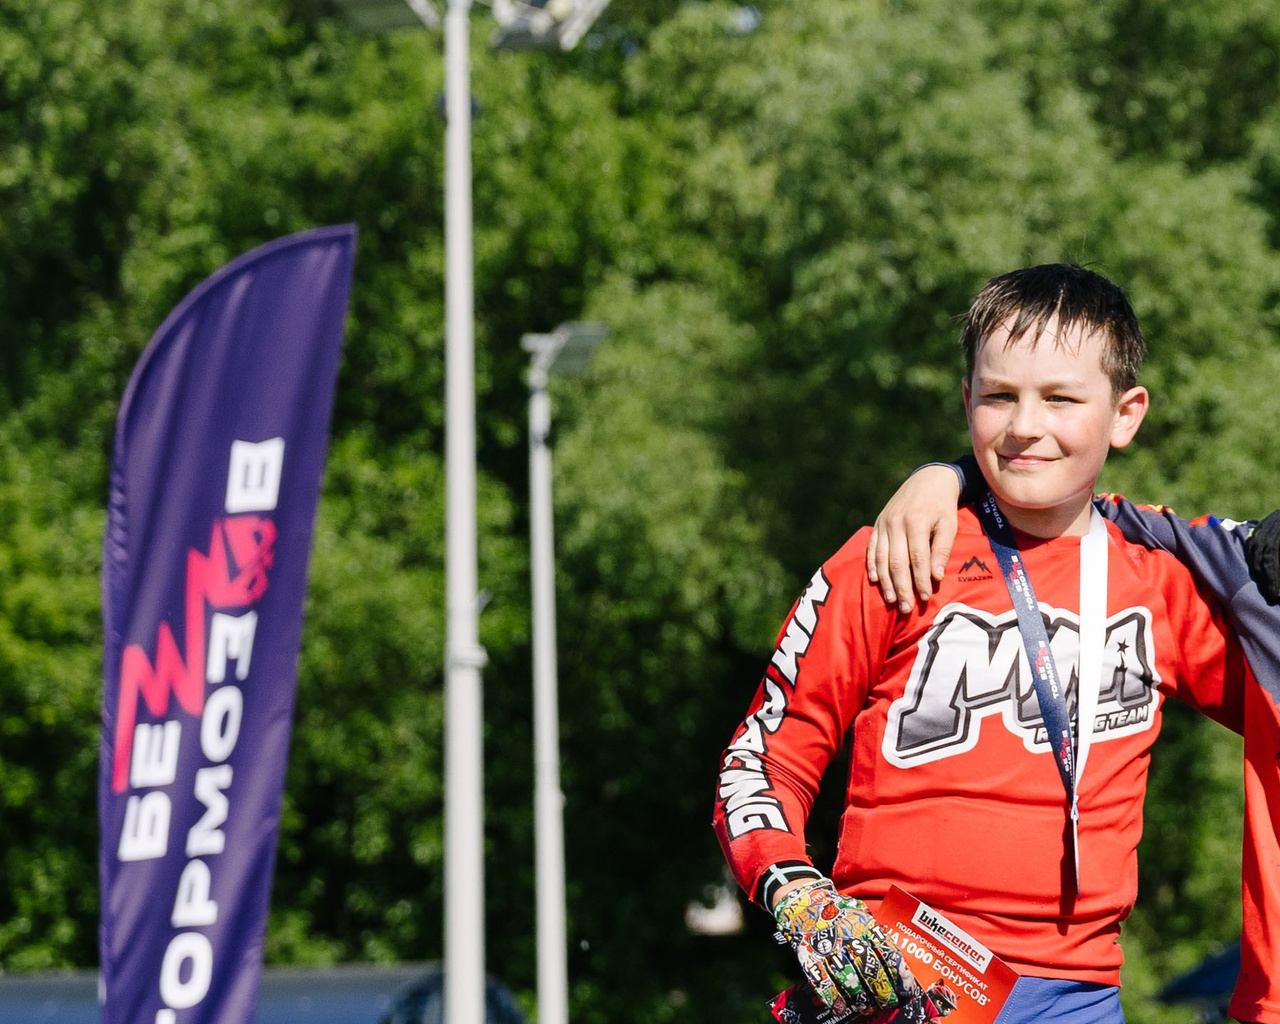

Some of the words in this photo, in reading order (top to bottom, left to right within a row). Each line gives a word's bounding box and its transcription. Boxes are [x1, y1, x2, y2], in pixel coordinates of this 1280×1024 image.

[1108, 705, 1148, 730] TEAM
[811, 928, 835, 944] FIST
[919, 910, 986, 963] bikecenter
[896, 921, 945, 957] ПОДАРОЧНЫЙ
[944, 953, 989, 991] СЕРТИФИКАТ
[900, 938, 934, 965] 1000
